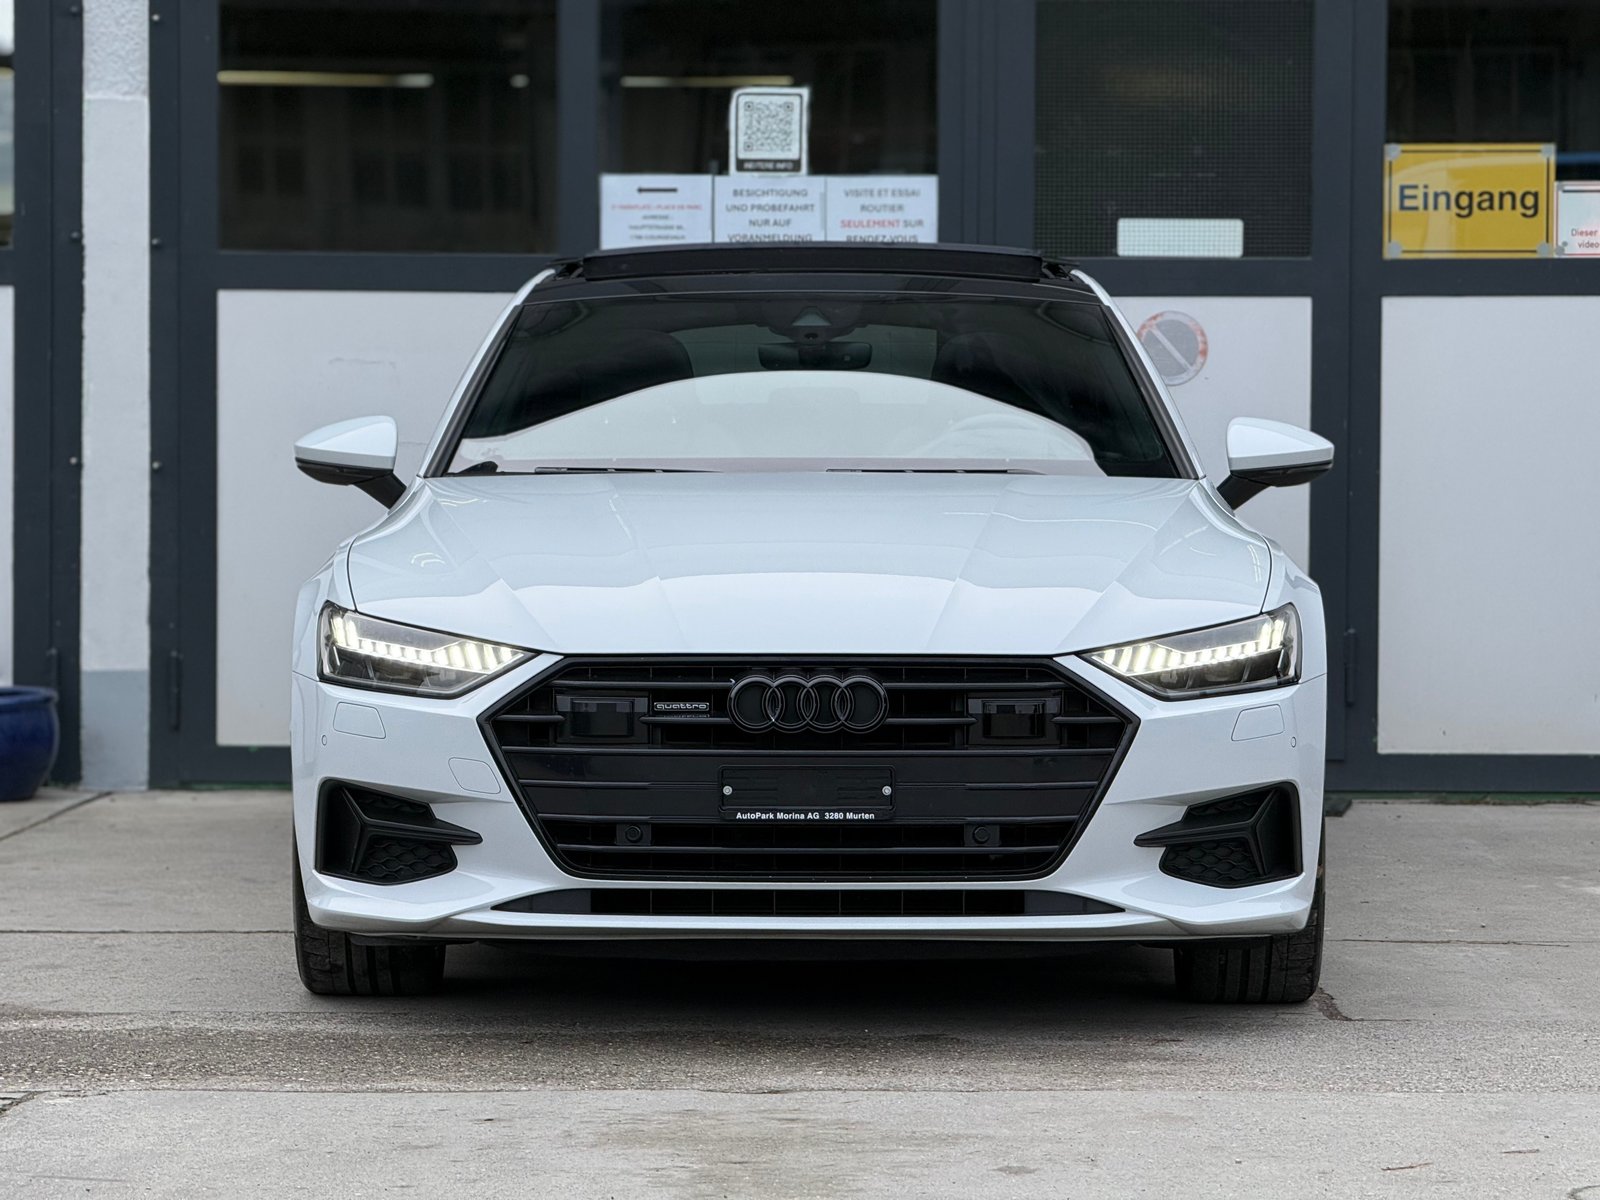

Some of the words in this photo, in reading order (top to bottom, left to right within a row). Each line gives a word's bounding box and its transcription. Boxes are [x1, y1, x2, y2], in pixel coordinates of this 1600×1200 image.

[733, 188, 808, 197] BESICHTIGUNG
[844, 188, 874, 197] VISITE
[877, 188, 889, 197] ET
[891, 188, 921, 197] ESSAI
[1398, 184, 1539, 218] Eingang
[726, 204, 748, 213] UND
[750, 204, 815, 213] PROBEFAHRT
[860, 204, 904, 213] ROUTIER
[749, 219, 771, 227] NUR
[772, 219, 791, 227] AUF
[841, 219, 900, 228] SEULEMENT
[903, 219, 924, 228] SUR
[1571, 228, 1598, 237] Dieser
[736, 812, 775, 820] AutoPark
[777, 812, 805, 820] Morina
[807, 812, 820, 820] AG
[824, 812, 844, 820] 3280
[846, 812, 875, 820] Murten
